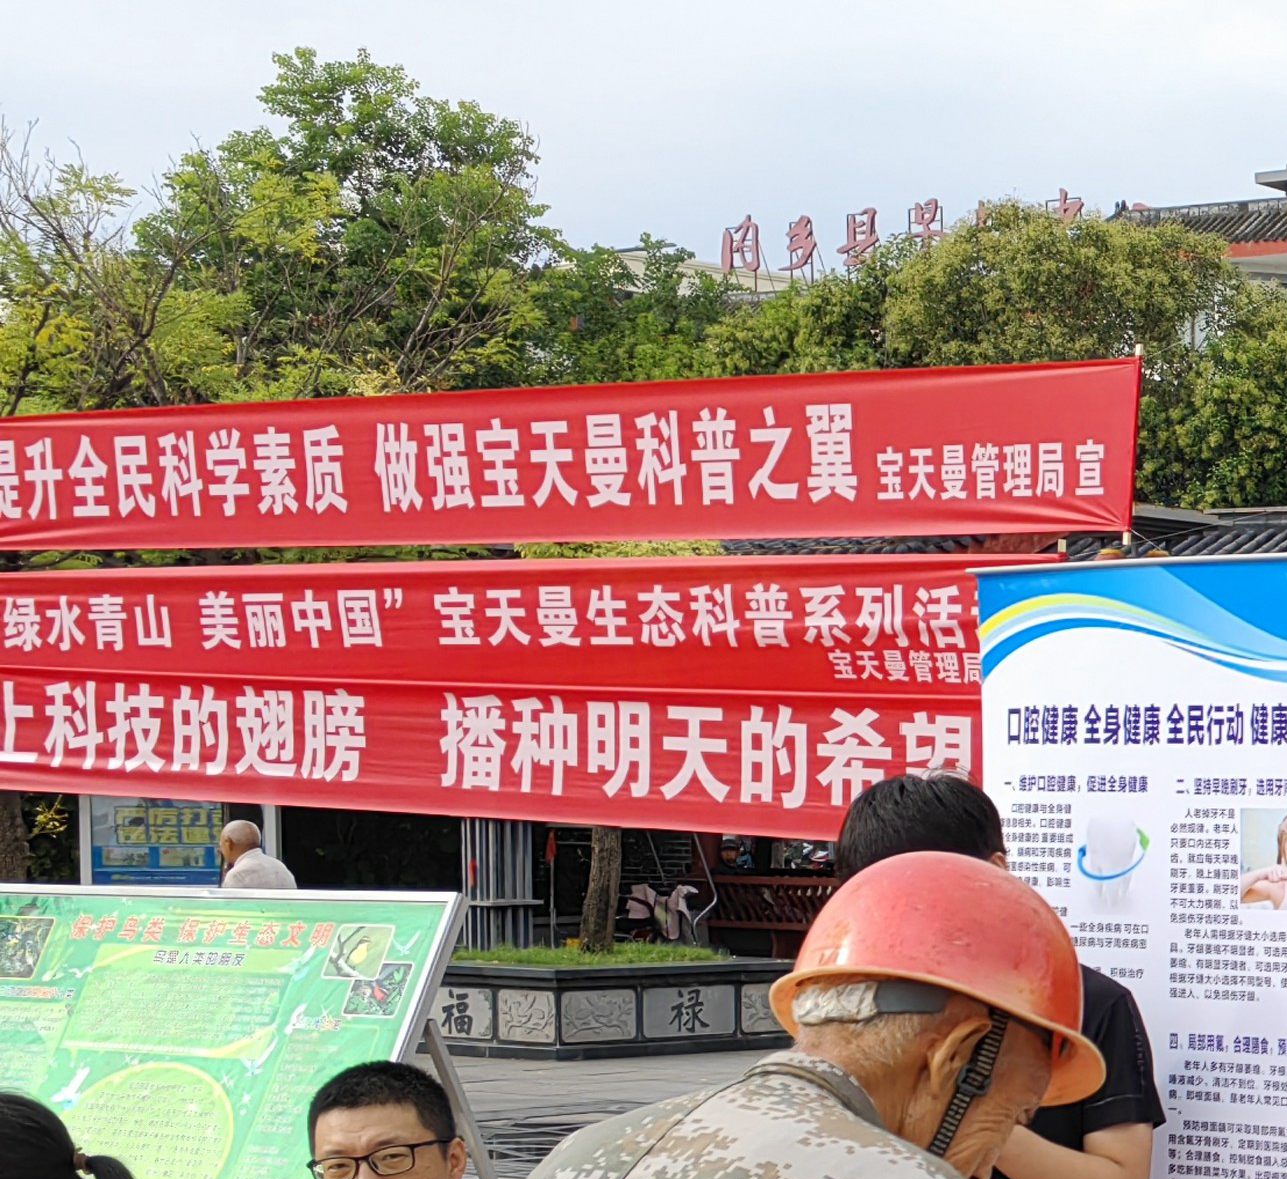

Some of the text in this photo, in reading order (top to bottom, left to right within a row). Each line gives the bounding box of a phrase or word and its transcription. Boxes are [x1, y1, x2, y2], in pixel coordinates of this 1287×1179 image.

[374, 403, 858, 512] 做强宝天曼科普之翼
[4, 592, 172, 652] 绿水青山
[434, 584, 979, 646] 宝天曼生态科普系列活
[830, 648, 982, 686] 宝天曼管理局
[0, 678, 973, 812] 上科技的翅膀 播种明天的希望
[1008, 704, 1078, 745] 口腔健康
[1084, 704, 1160, 746] 全身健康
[1167, 703, 1244, 746] 全民行动
[69, 914, 336, 948] 保护鸟类 保护生态文明
[153, 949, 246, 967] 鸟是人类的朋友
[441, 988, 474, 1038] 福
[668, 987, 712, 1034] 禄
